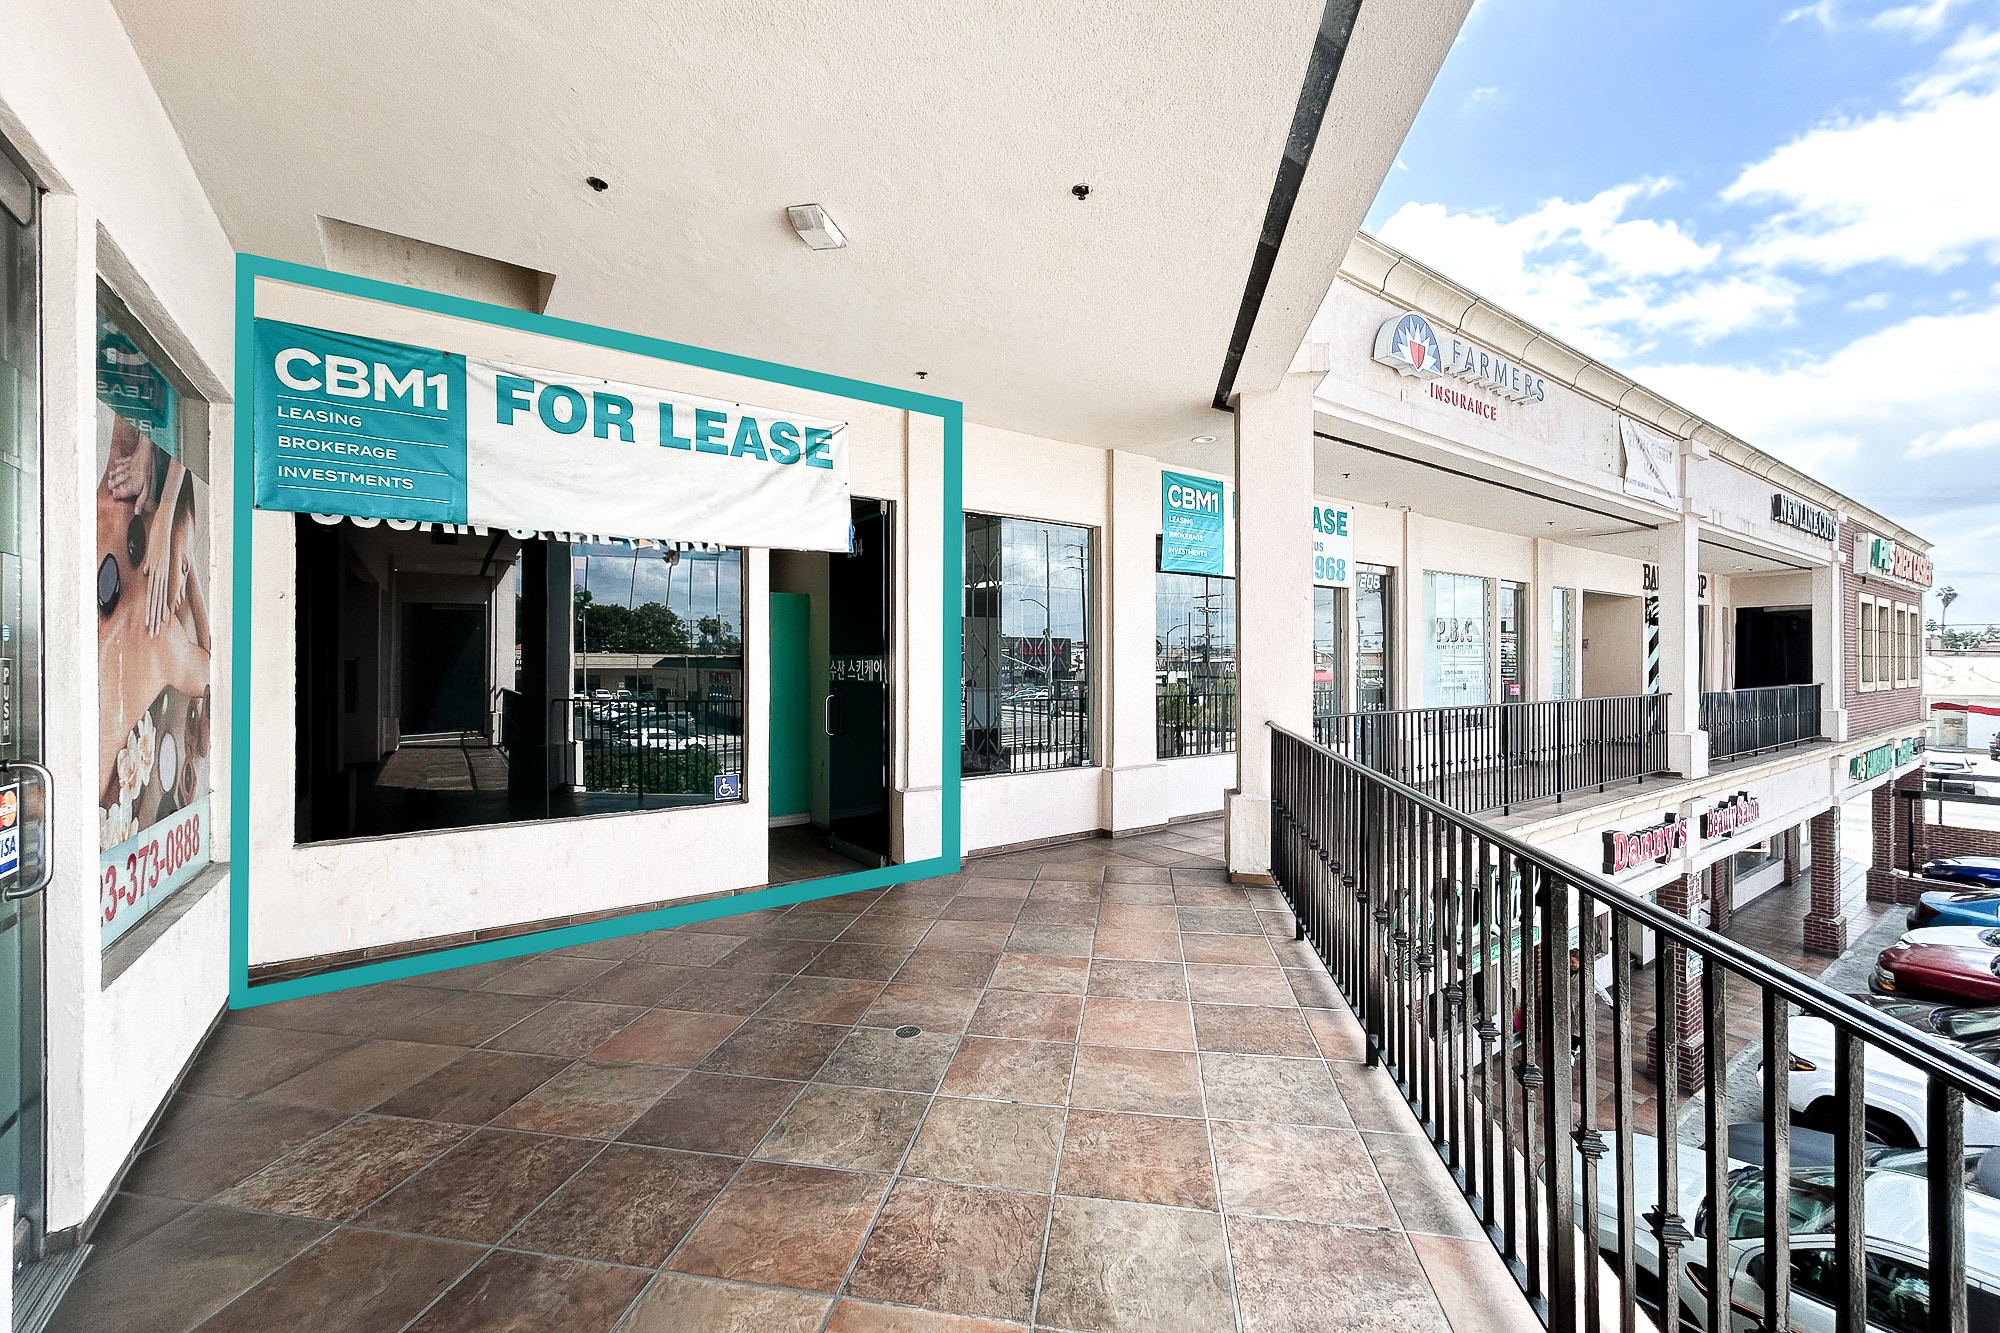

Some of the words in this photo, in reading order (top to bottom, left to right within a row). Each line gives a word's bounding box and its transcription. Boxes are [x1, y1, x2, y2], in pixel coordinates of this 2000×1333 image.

[273, 346, 449, 412] CBM1
[1452, 338, 1546, 403] FARMERS
[1429, 381, 1497, 422] INSURANCE
[277, 405, 362, 428] LEASING
[495, 373, 635, 443] FOR
[658, 401, 834, 471] LEASE
[277, 435, 398, 461] BROKERAGE
[277, 464, 415, 491] INVESTMENTS
[1167, 484, 1219, 514] CBM1
[1168, 515, 1194, 526] LEASING
[847, 538, 864, 559] 04
[1168, 531, 1204, 542] BROKERAGE
[1314, 555, 1346, 582] 968
[1642, 563, 1660, 591] BA
[847, 659, 883, 682] 스킨케어
[1612, 813, 1687, 875] Danny's
[1736, 794, 1760, 826] Salon
